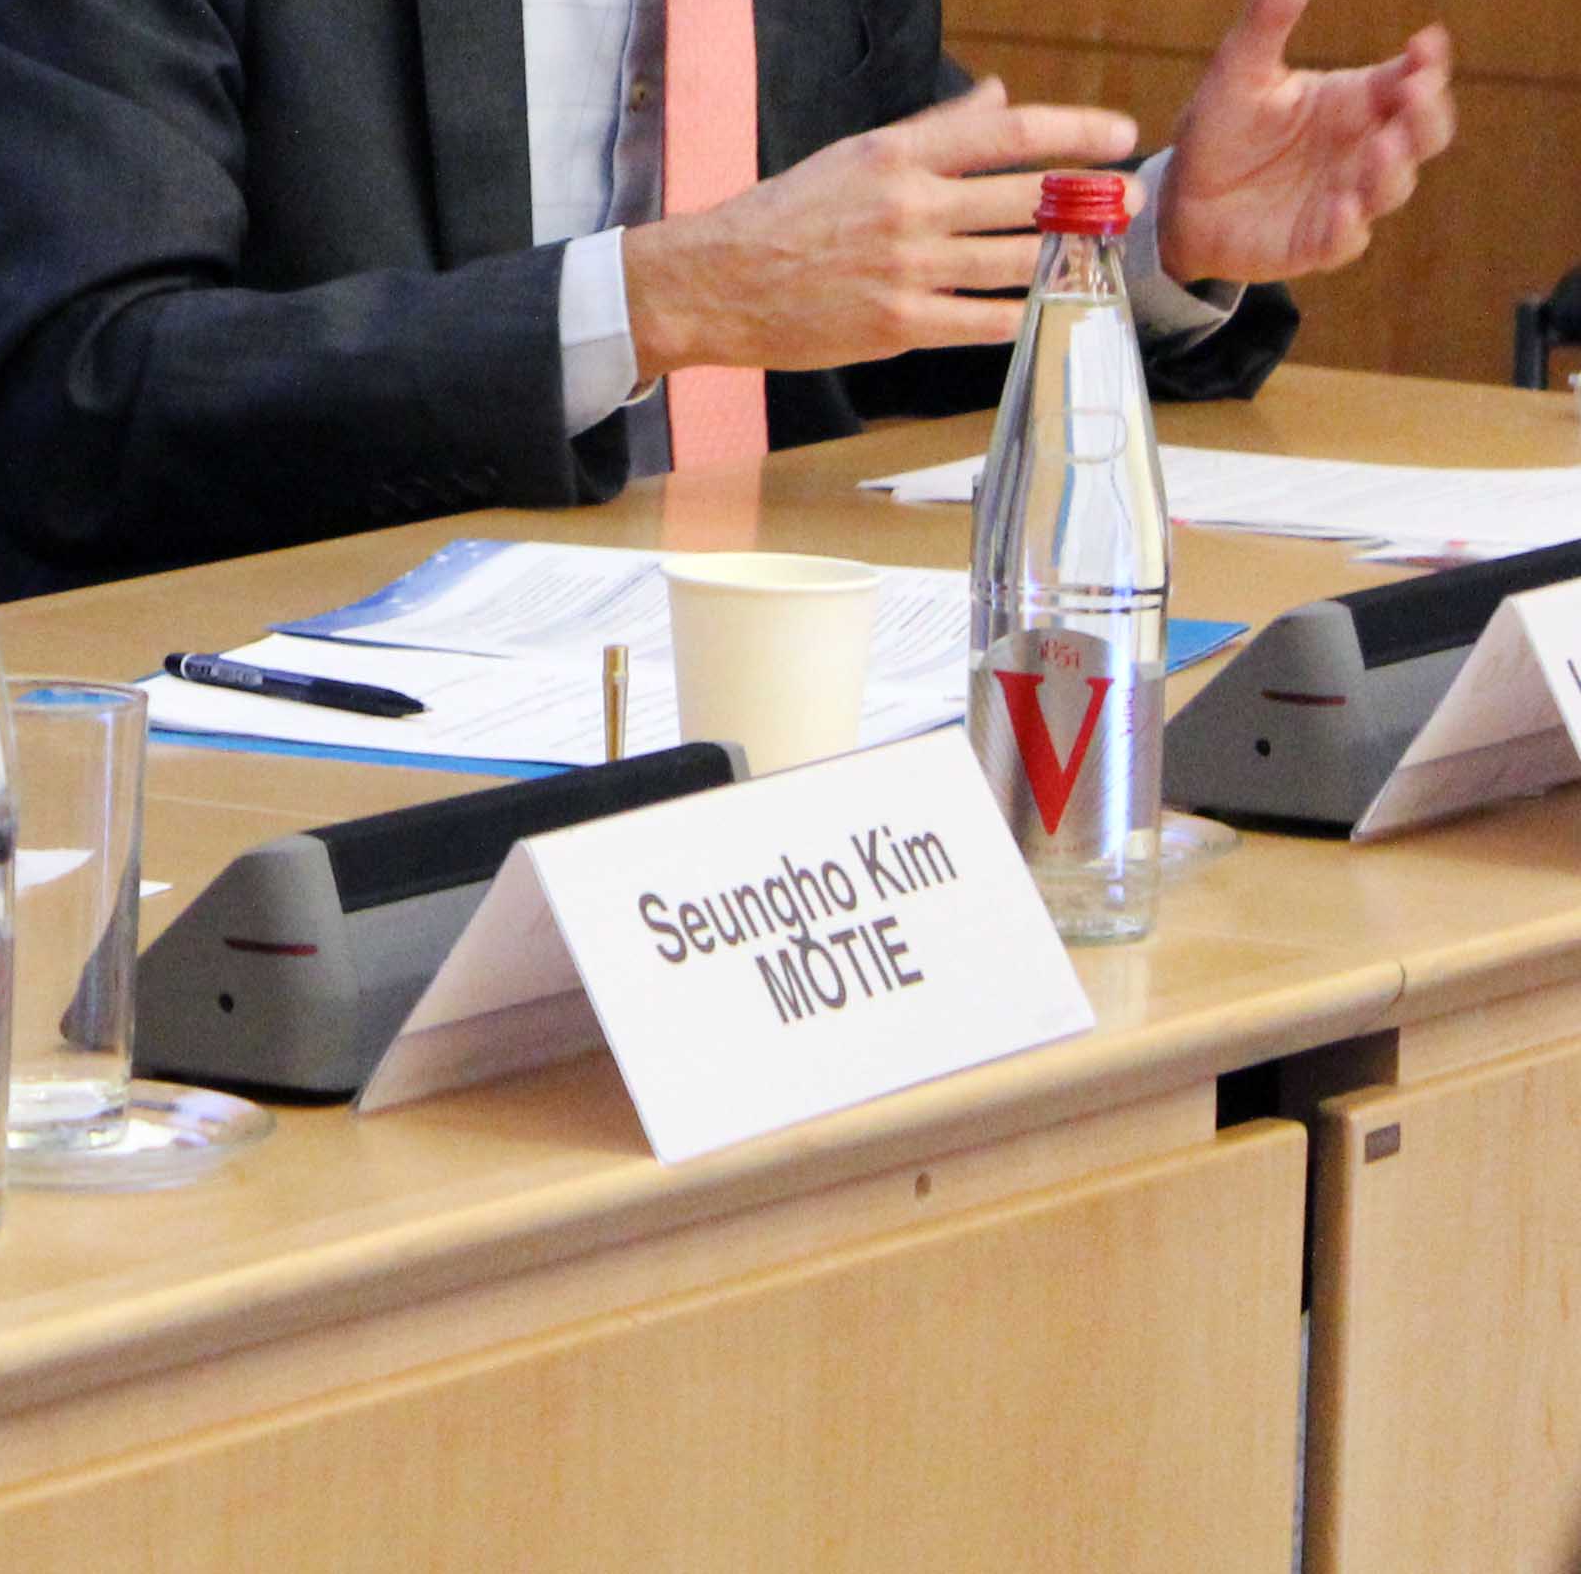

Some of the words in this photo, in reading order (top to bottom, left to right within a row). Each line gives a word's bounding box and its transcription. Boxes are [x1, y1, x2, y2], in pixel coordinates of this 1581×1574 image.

[993, 669, 1115, 836] V
[638, 854, 858, 965] Seungho
[851, 825, 958, 901] Kim
[755, 916, 924, 1025] MOTIE
